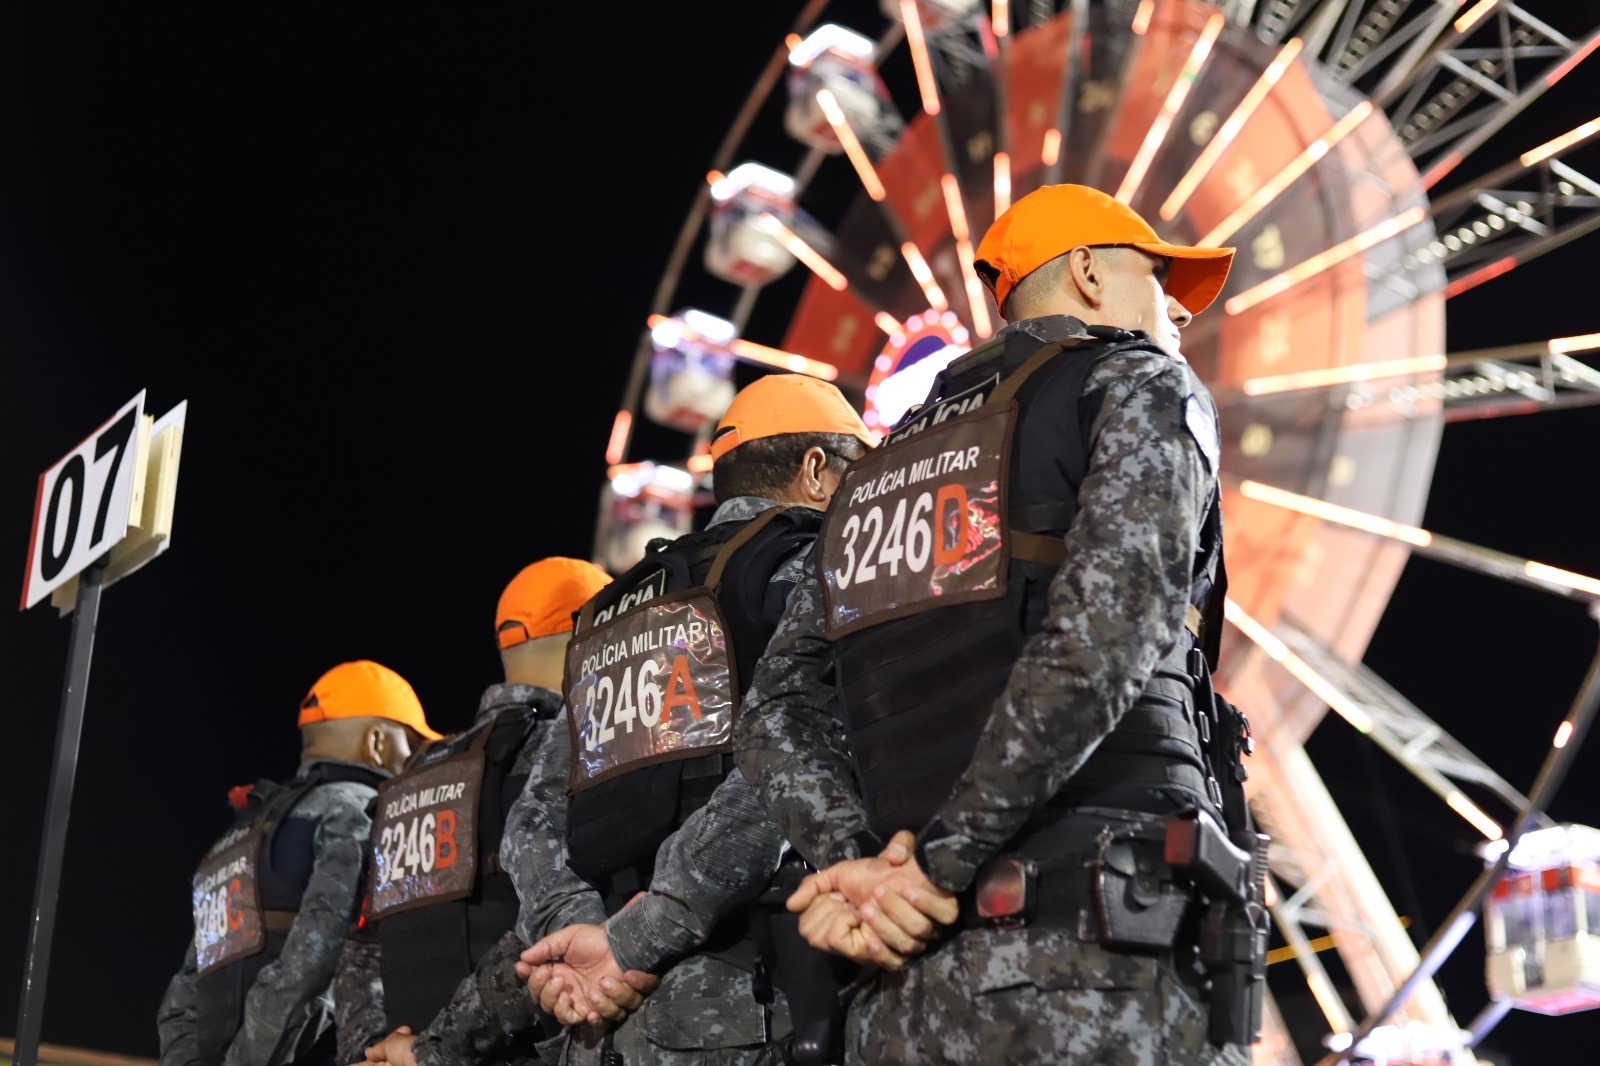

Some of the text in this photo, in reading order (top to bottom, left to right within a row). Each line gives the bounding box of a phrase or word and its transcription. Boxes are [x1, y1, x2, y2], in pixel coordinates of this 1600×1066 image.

[40, 404, 138, 582] 07
[850, 446, 980, 506] POLÍCIA MILITAR
[835, 484, 969, 590] 3246D
[593, 584, 654, 627] OLÍCIA
[581, 622, 703, 680] POLÍCIA MILITAR
[584, 655, 704, 752] 3246A
[384, 782, 465, 821] POLÍCIA MILITAR
[380, 809, 458, 885] 3246B
